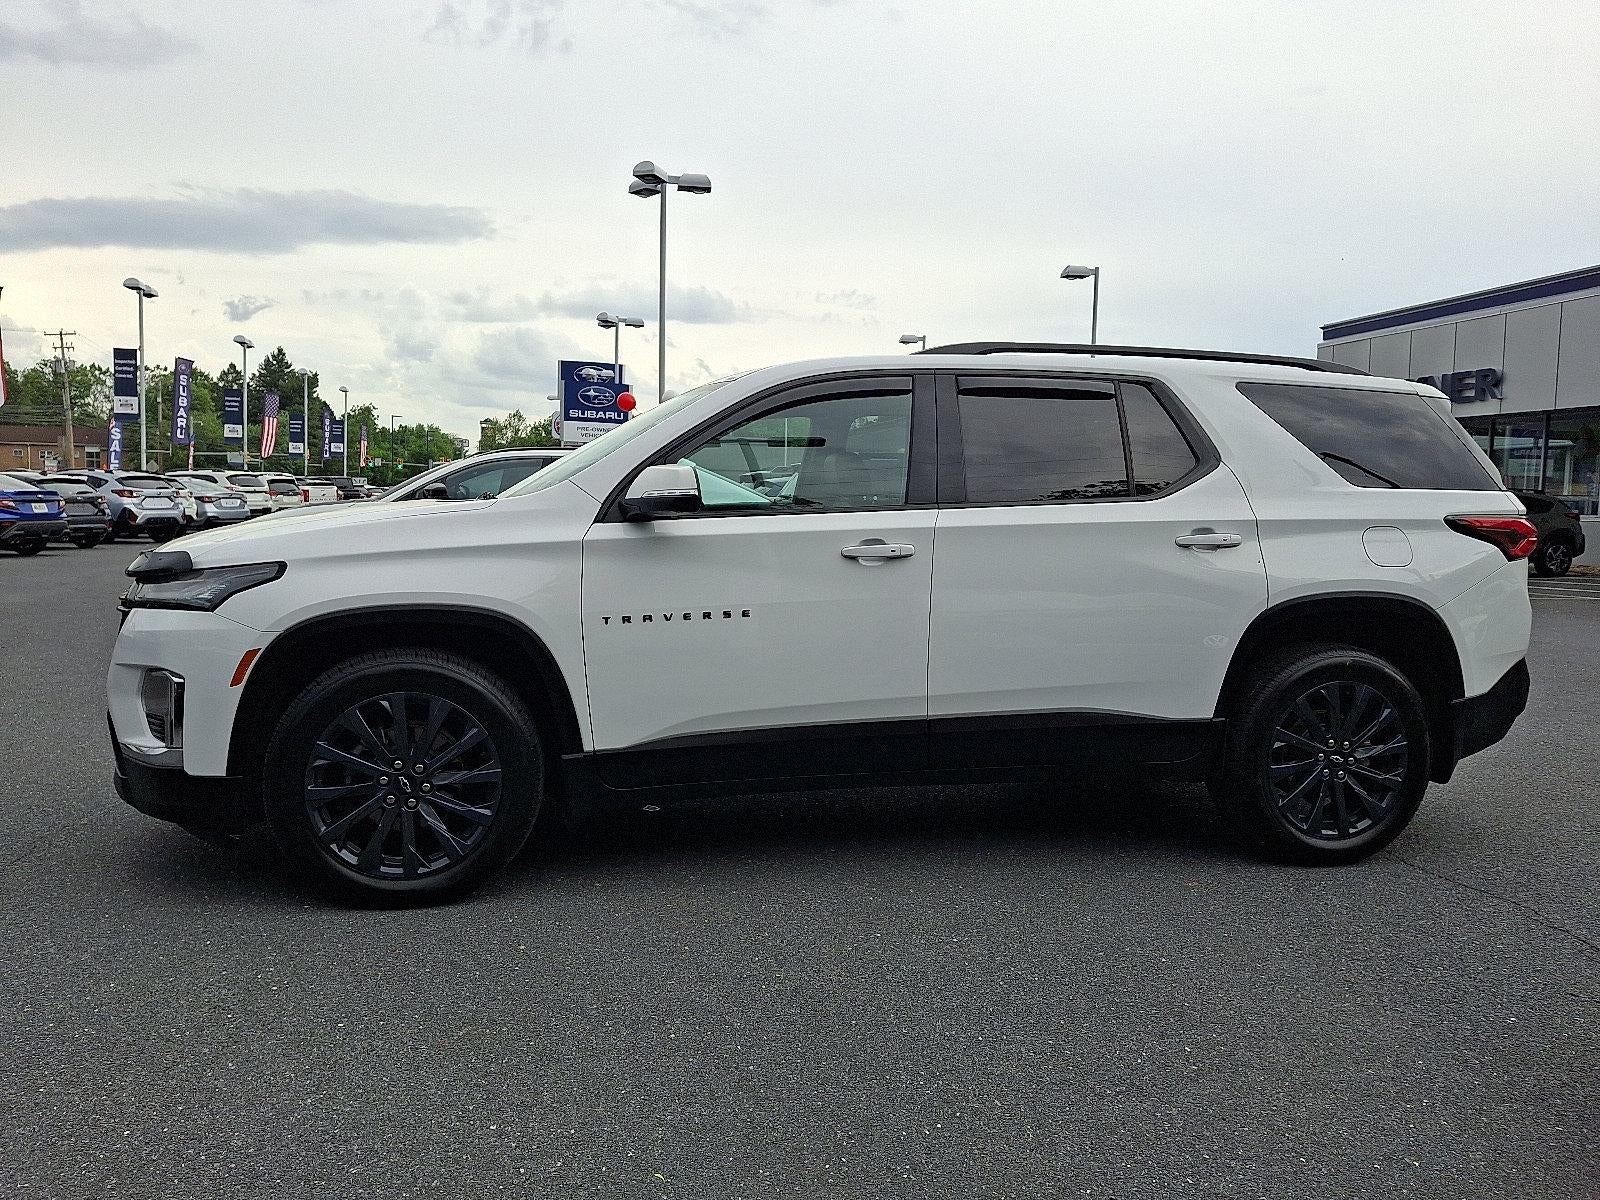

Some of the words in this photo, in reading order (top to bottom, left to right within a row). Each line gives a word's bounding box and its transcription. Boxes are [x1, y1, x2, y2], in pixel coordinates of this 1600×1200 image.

[177, 375, 187, 438] SUBARU
[569, 409, 624, 420] SUBARU
[602, 609, 750, 625] TRAVERSE
